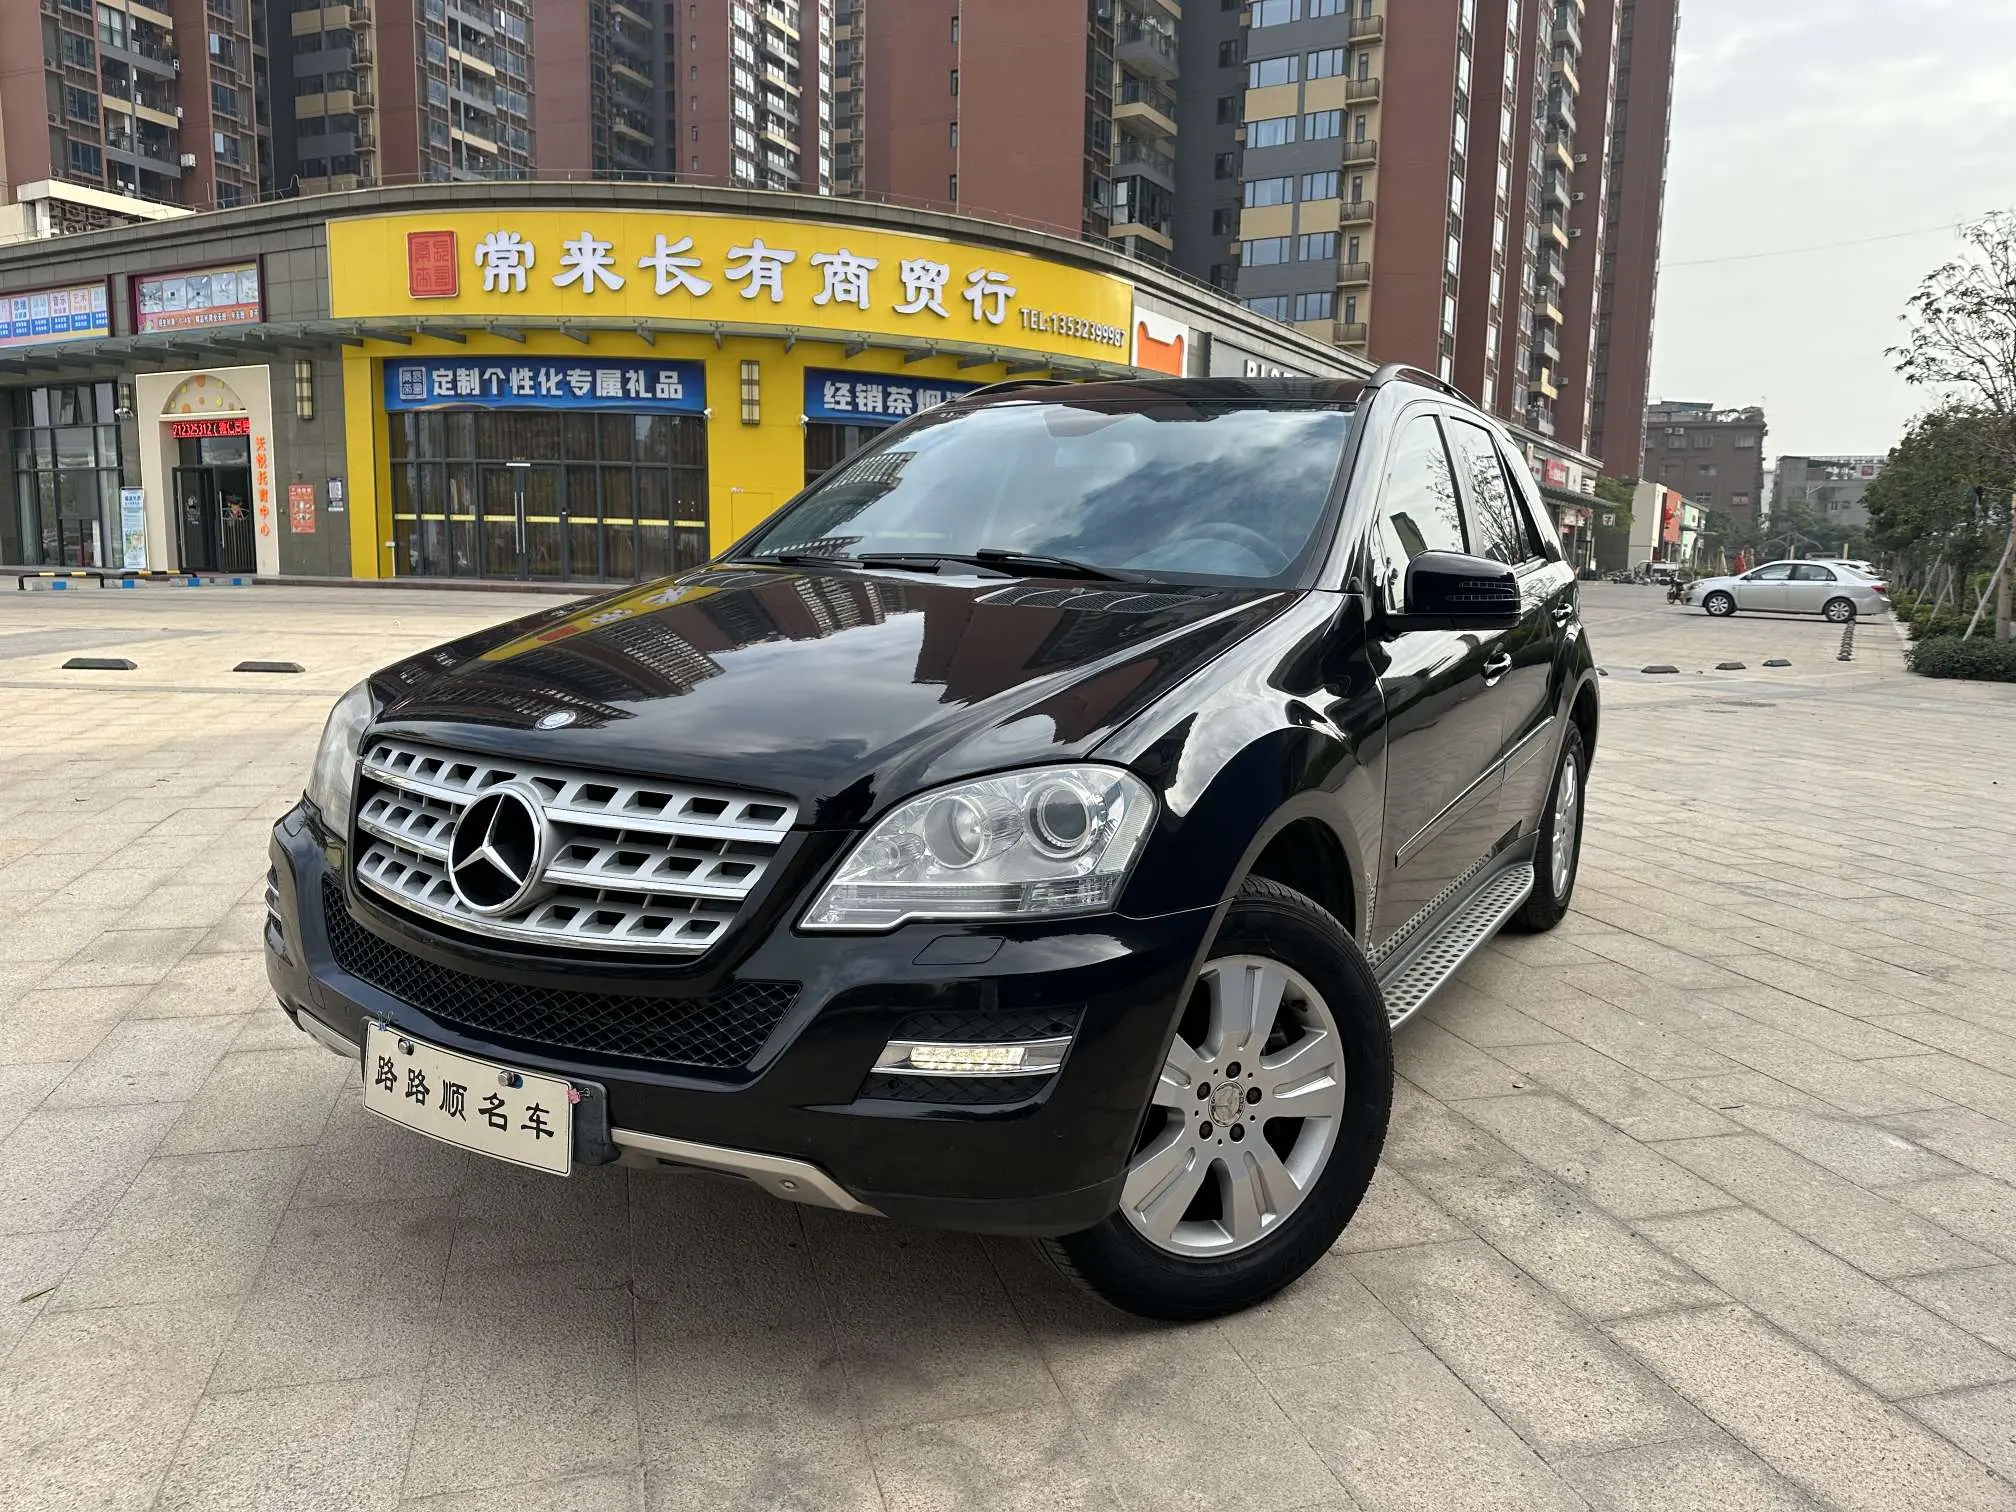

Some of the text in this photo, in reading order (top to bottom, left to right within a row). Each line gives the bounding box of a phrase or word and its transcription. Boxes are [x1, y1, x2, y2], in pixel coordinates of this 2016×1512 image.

[474, 230, 1017, 326] 常来长有商贸行
[1019, 308, 1125, 347] TEL:13532399987
[432, 366, 684, 399] 定制个性化专属礼品
[375, 1055, 555, 1140] 路路顺名车
